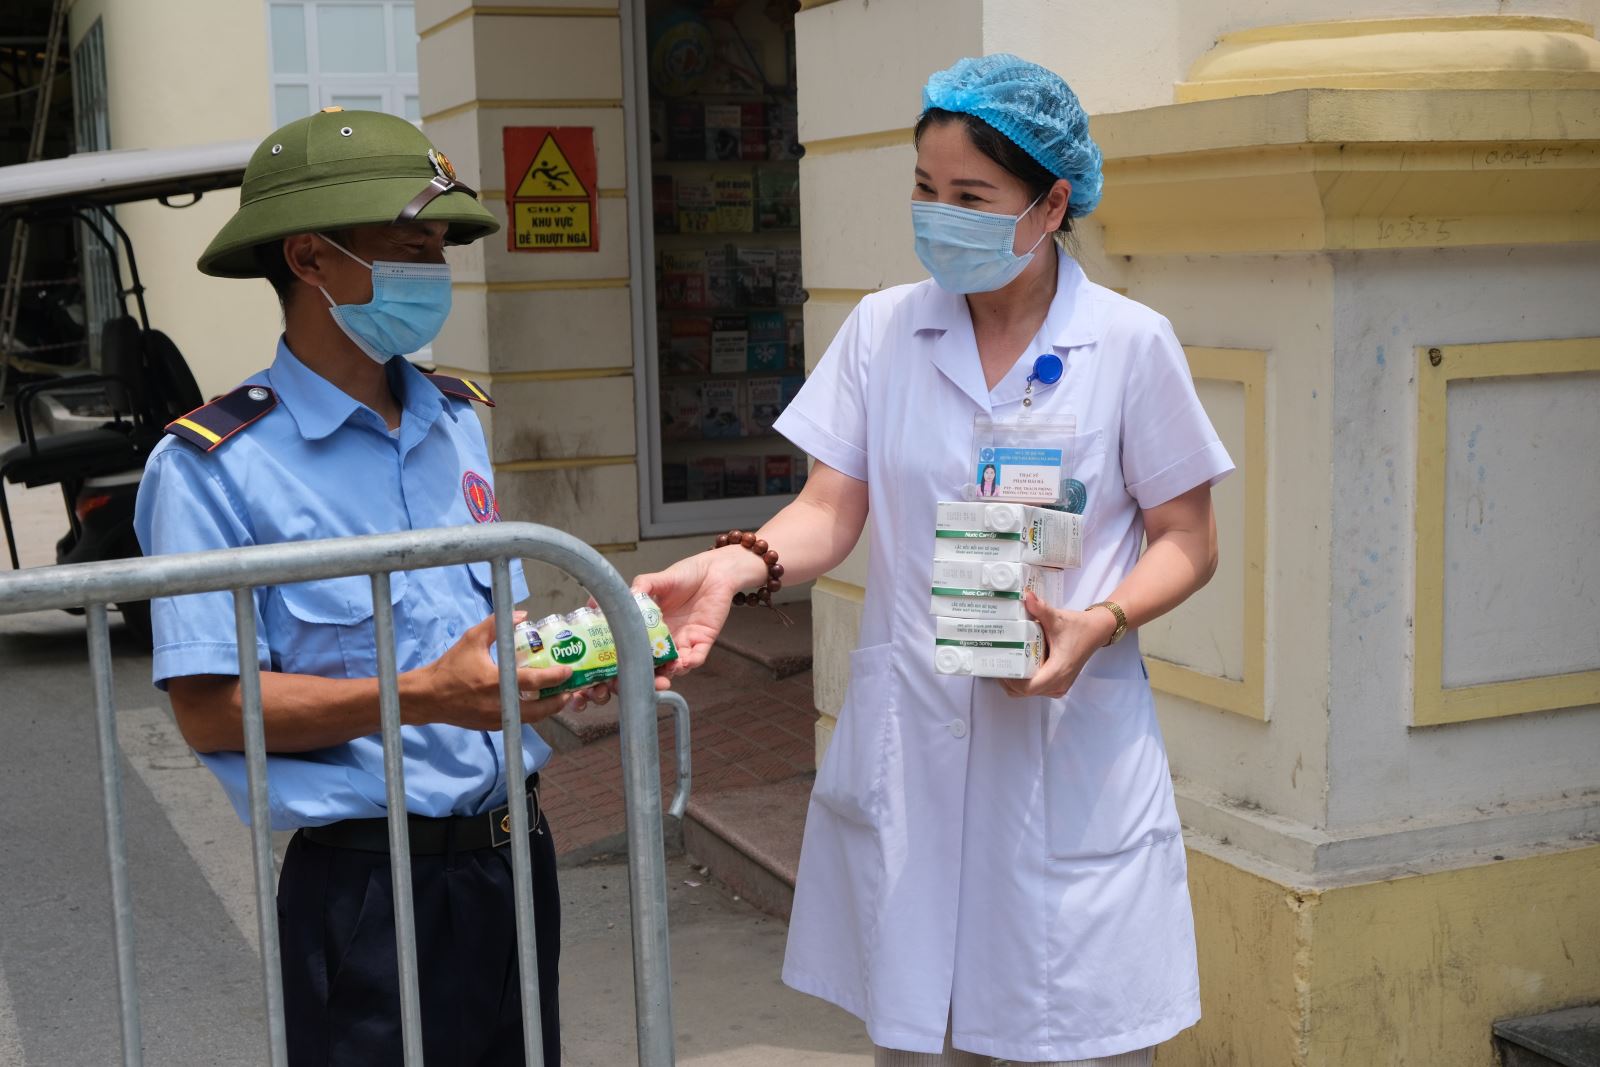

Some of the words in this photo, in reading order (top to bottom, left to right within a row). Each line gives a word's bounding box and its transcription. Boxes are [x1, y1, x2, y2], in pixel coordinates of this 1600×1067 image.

[531, 216, 551, 228] KHU
[554, 216, 574, 229] VỰC
[535, 232, 564, 246] TRƯỢT
[552, 640, 583, 660] Proby
